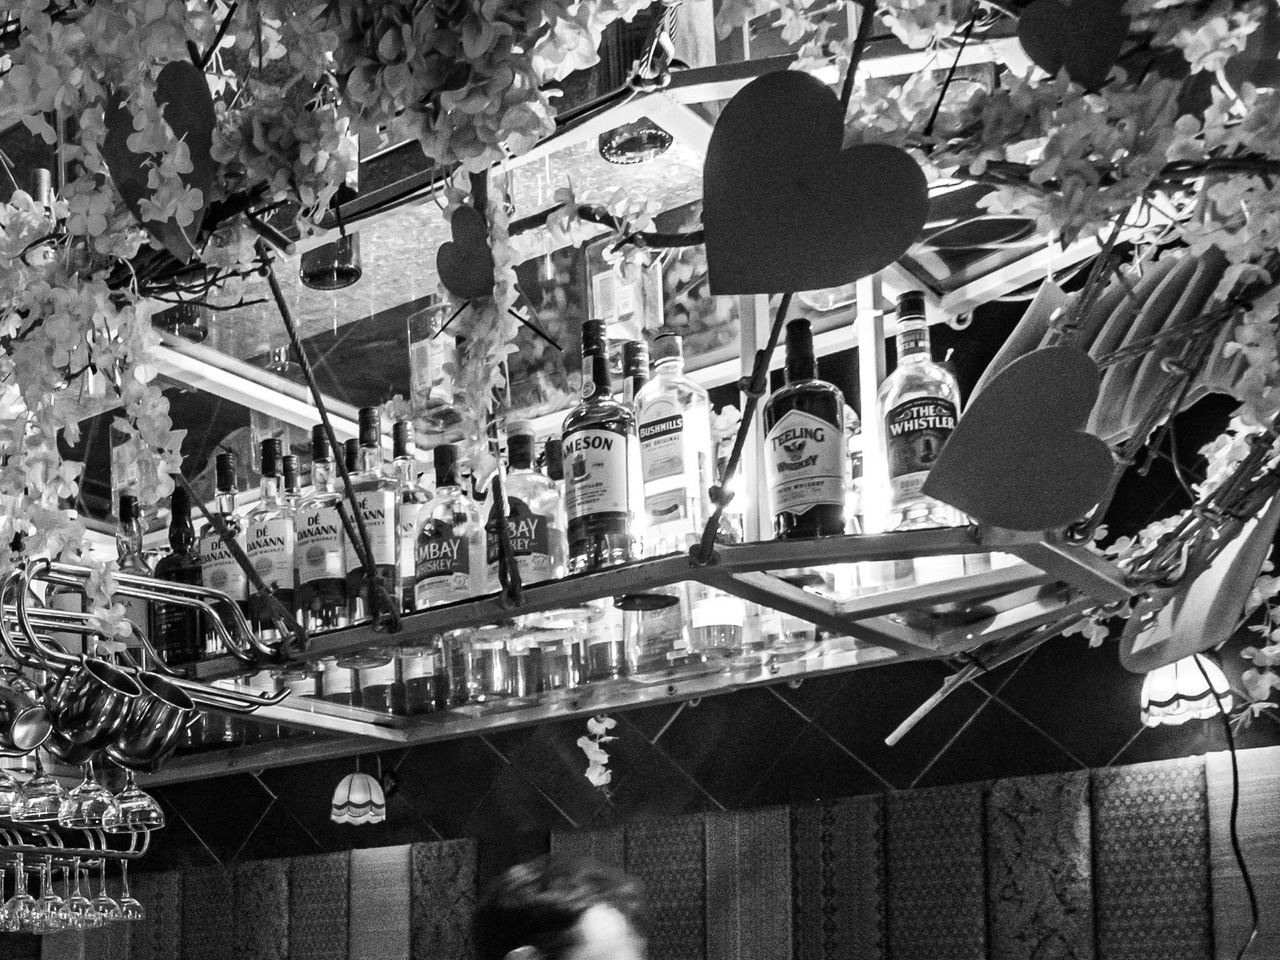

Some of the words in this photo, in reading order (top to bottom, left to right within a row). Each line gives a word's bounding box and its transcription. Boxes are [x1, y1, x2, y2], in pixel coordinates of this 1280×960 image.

[910, 405, 936, 418] THE
[640, 418, 683, 438] BUSHMILLS
[890, 417, 955, 436] WHISTLER
[771, 427, 825, 452] TEELING
[777, 454, 818, 473] WHISKEY
[307, 512, 321, 526] DÉ
[256, 525, 268, 538] DÉ
[297, 525, 338, 541] DANANN
[246, 536, 285, 554] DANANN
[200, 550, 232, 564] DANAN
